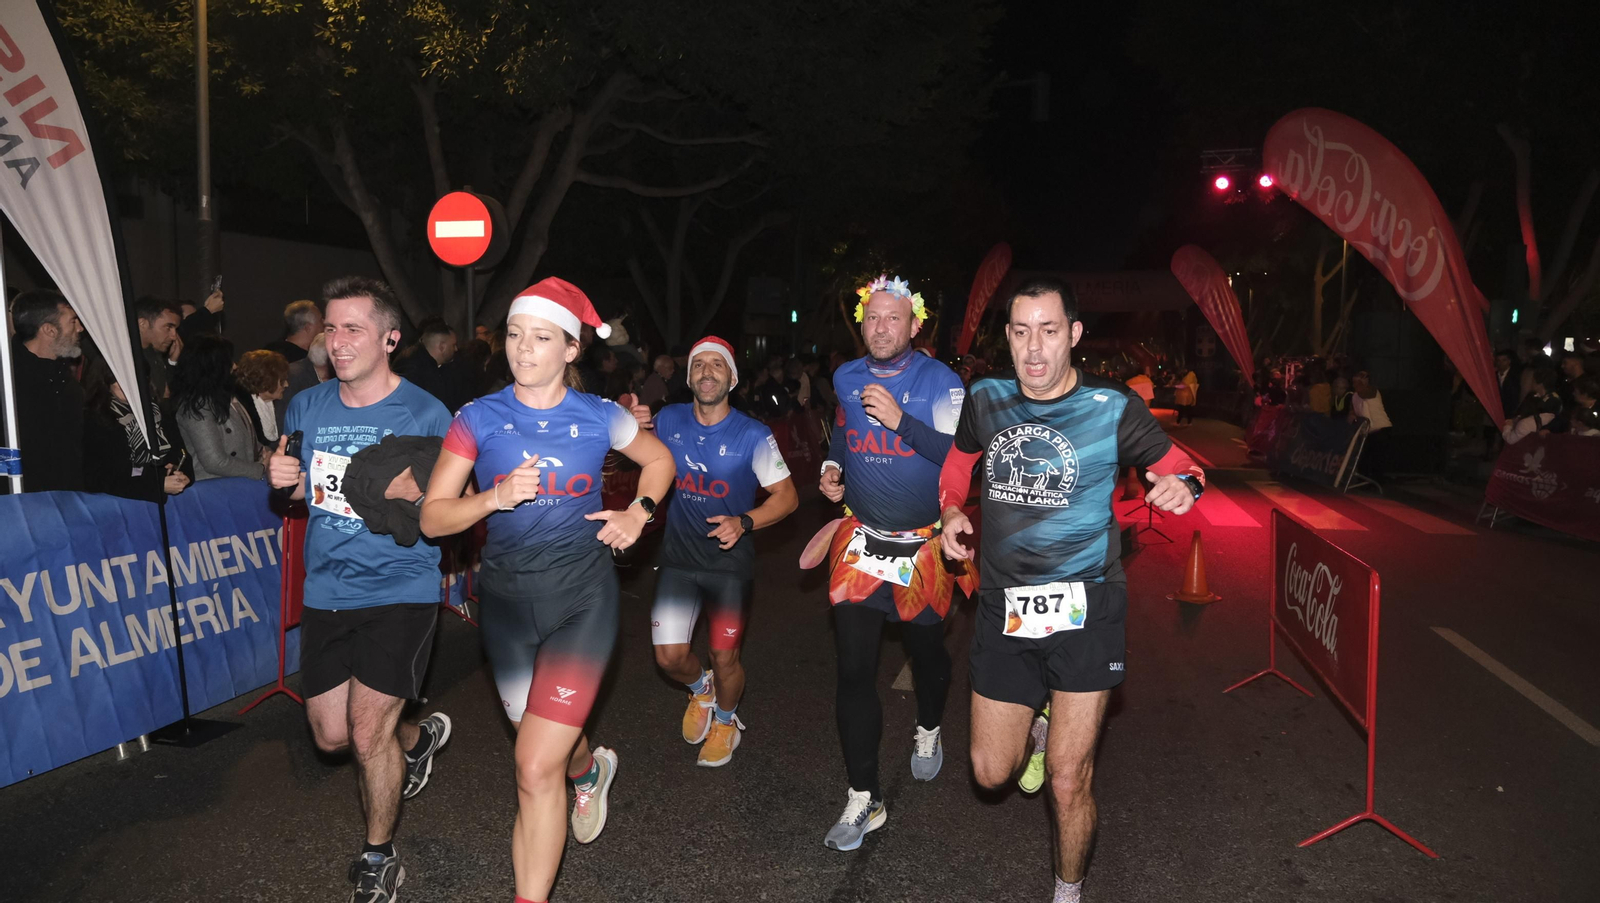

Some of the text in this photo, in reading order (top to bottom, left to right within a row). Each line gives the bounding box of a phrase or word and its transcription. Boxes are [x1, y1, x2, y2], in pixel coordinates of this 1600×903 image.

[327, 426, 342, 434] SAN
[342, 425, 378, 435] SILVESTRE
[338, 434, 347, 442] DE
[864, 456, 893, 465] SPORT
[986, 435, 1008, 478] TIRADA
[1007, 426, 1051, 440] LARGA
[327, 462, 345, 472] CIUDA
[493, 471, 594, 498] LO
[682, 492, 707, 503] SPORT
[988, 488, 1069, 506] TIRADA LARGA
[0, 526, 283, 628] YUNTAMIENT
[1016, 593, 1065, 616] 787
[70, 582, 260, 678] ALMERÍA
